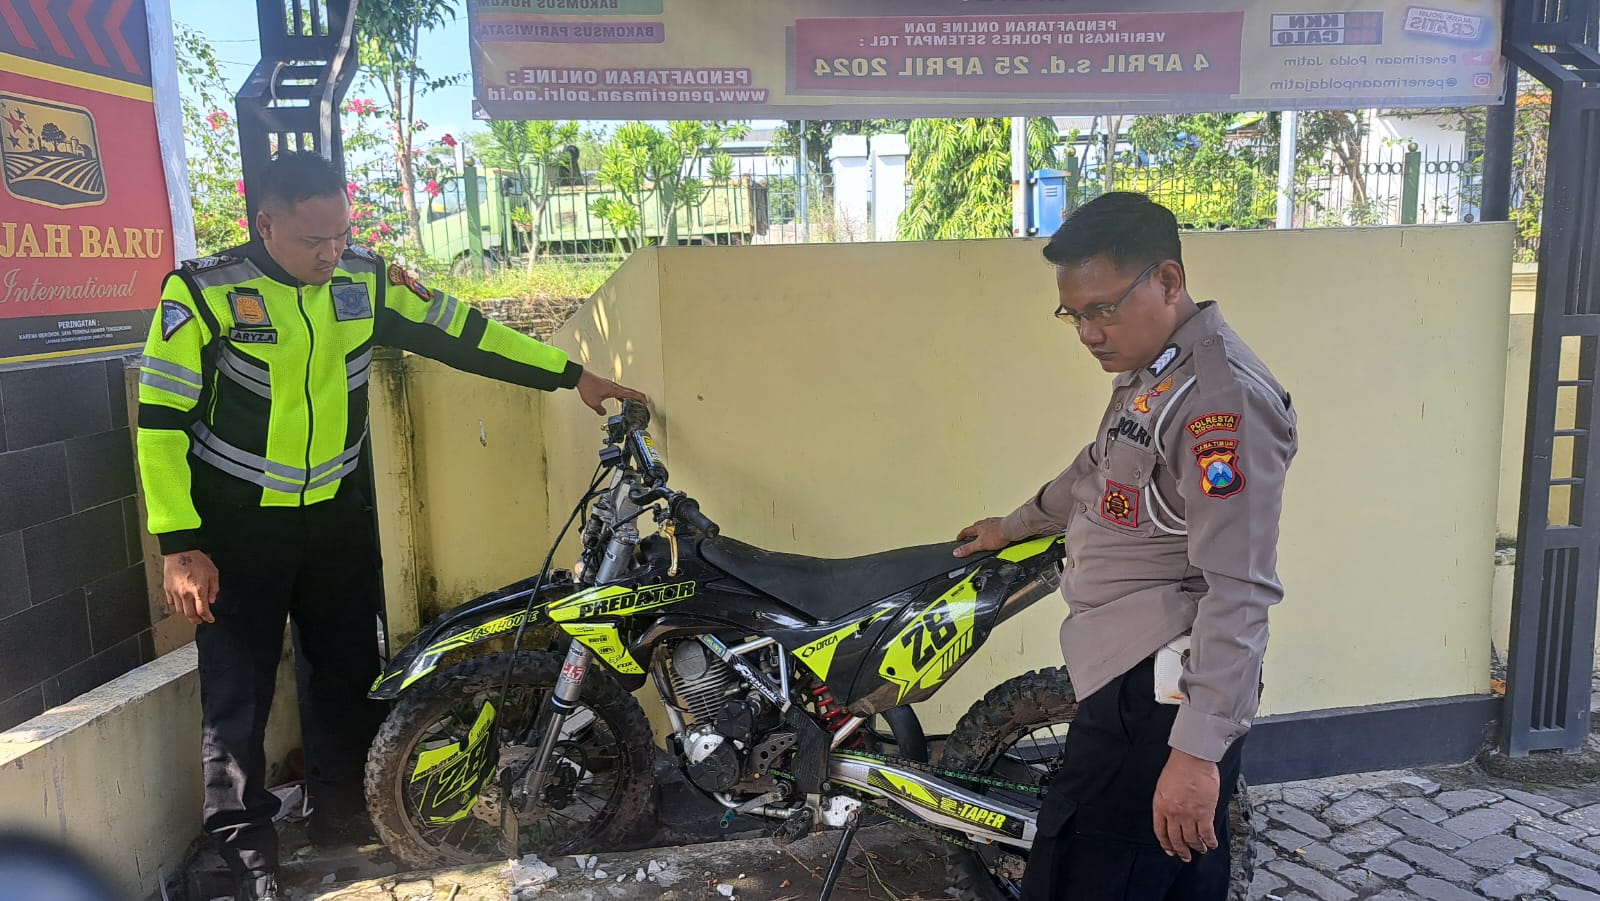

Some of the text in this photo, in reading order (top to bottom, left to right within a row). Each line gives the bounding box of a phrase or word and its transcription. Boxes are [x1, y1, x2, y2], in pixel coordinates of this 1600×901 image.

[0, 222, 164, 259] JAH BARU
[0, 267, 137, 303] International
[58, 319, 97, 330] PERINGATAN
[1190, 415, 1235, 431] POLRESTA
[579, 580, 696, 618] PREDATOR
[470, 610, 540, 640] FASTHOUE
[901, 599, 958, 672] 28
